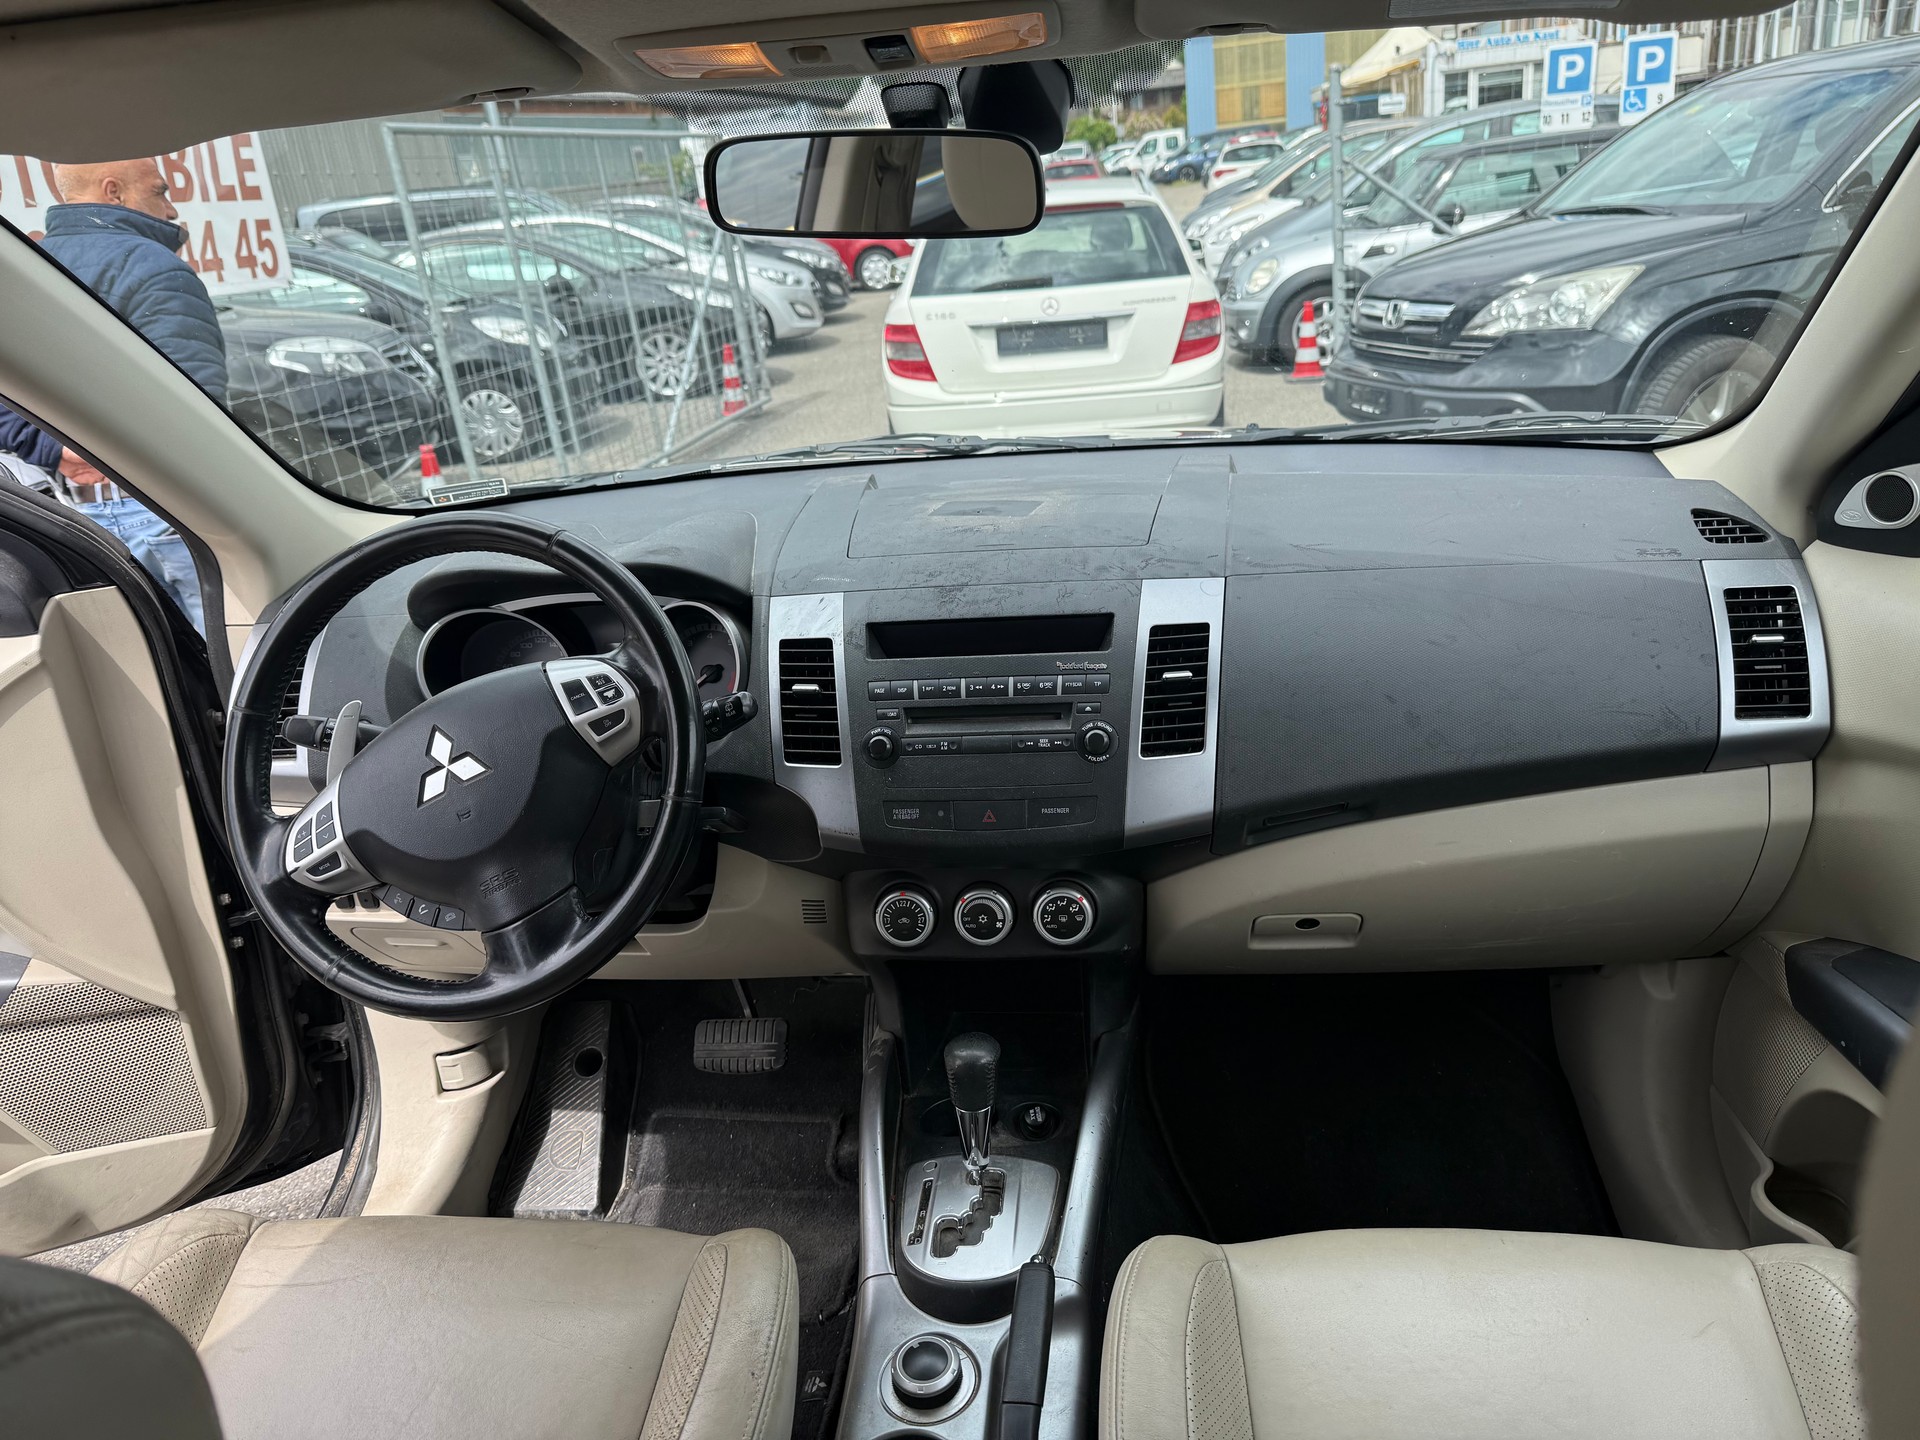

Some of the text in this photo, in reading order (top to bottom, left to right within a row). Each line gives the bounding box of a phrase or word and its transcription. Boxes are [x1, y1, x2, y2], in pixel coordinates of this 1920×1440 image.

[1556, 53, 1585, 90] P
[1636, 45, 1665, 82] P
[235, 217, 279, 279] 45
